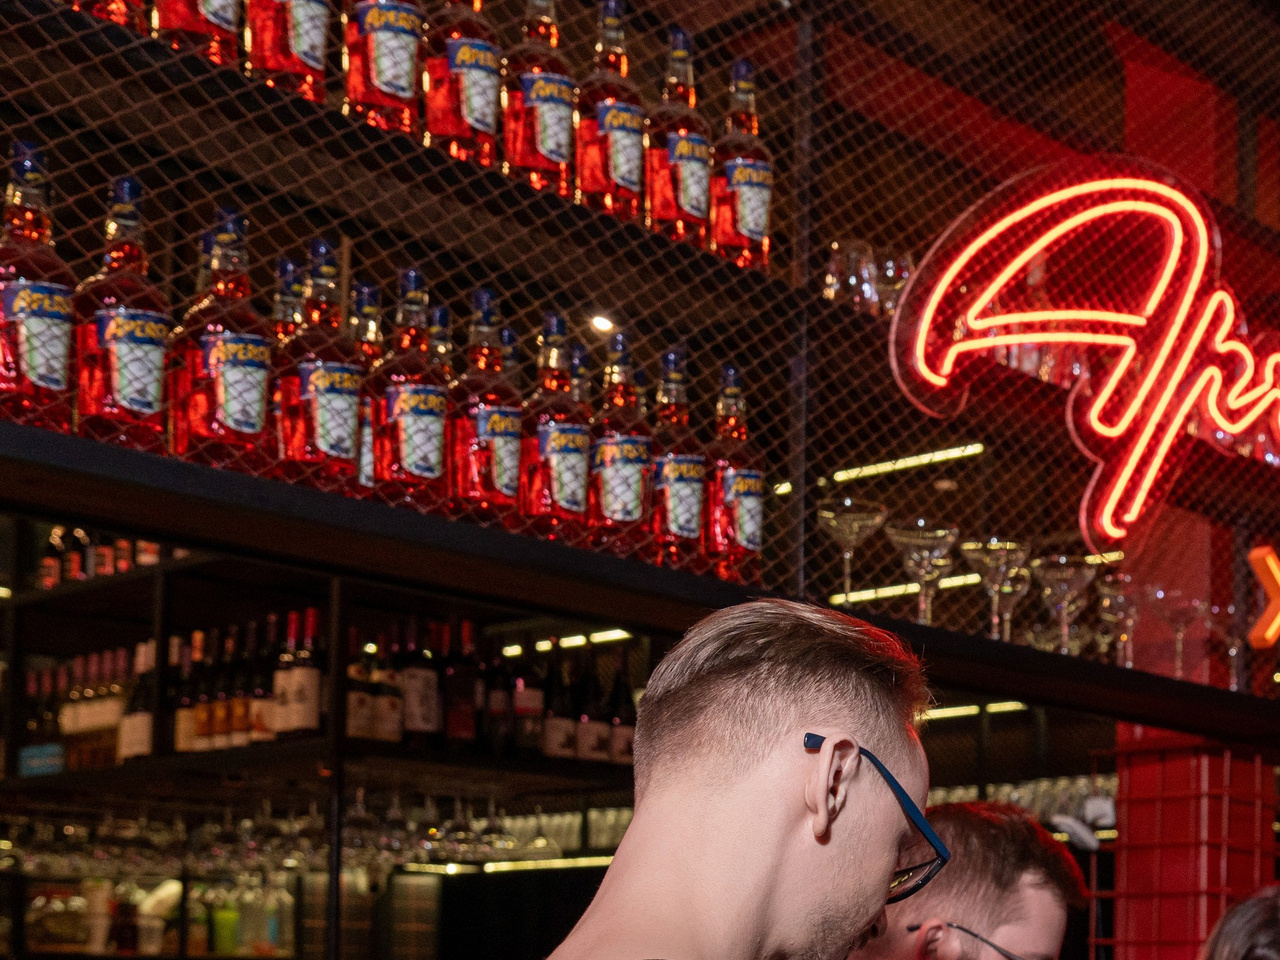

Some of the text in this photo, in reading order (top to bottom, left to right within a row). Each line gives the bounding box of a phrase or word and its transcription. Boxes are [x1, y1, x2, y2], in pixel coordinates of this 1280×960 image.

[104, 317, 168, 341] APERO
[208, 340, 271, 363] APERO
[392, 393, 447, 417] APERO
